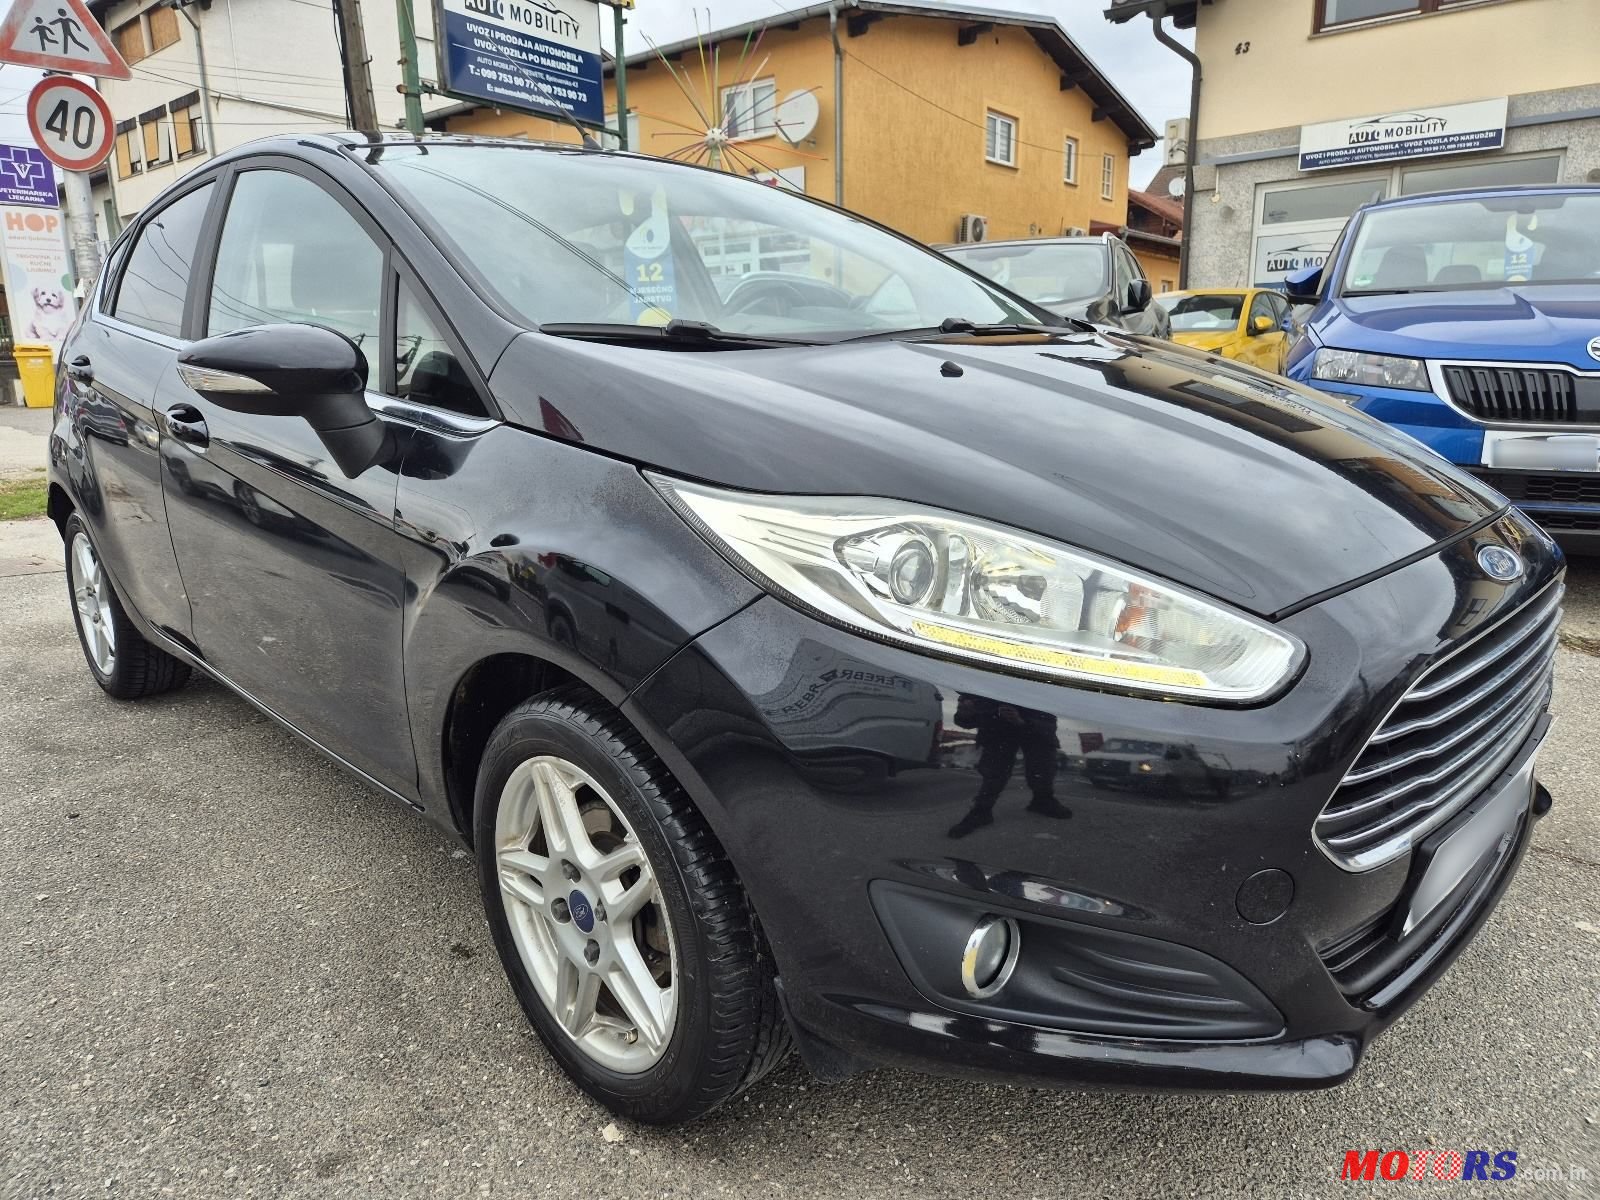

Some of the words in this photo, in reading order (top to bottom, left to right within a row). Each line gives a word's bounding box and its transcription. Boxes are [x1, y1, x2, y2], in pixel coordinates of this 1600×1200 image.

[510, 4, 579, 39] MOBILITY
[467, 22, 489, 38] UVOZ
[495, 30, 533, 50] PRODAJA
[534, 42, 584, 64] AUTOMOBILA
[1234, 41, 1251, 55] 43
[474, 38, 498, 52] UVOZ
[498, 45, 528, 61] VOZILA
[528, 53, 540, 63] PO
[541, 57, 579, 74] NARUDŽBI
[46, 99, 96, 149] 40
[1349, 130, 1380, 144] AUTO
[1385, 121, 1447, 139] MOBILITY
[1305, 152, 1322, 162] UVOZ
[1327, 149, 1356, 159] PRODAJA
[1356, 143, 1399, 154] AUTOMOBILA
[1404, 141, 1423, 149] UVOZ
[1424, 138, 1448, 147] VOZILA
[1449, 136, 1459, 144] PO
[1460, 131, 1496, 142] NARUDŽBI
[8, 194, 46, 203] LJEKARNA
[5, 212, 58, 233] HOP
[1267, 258, 1298, 272] AUTO
[1511, 253, 1527, 264] 12
[636, 262, 664, 282] 12
